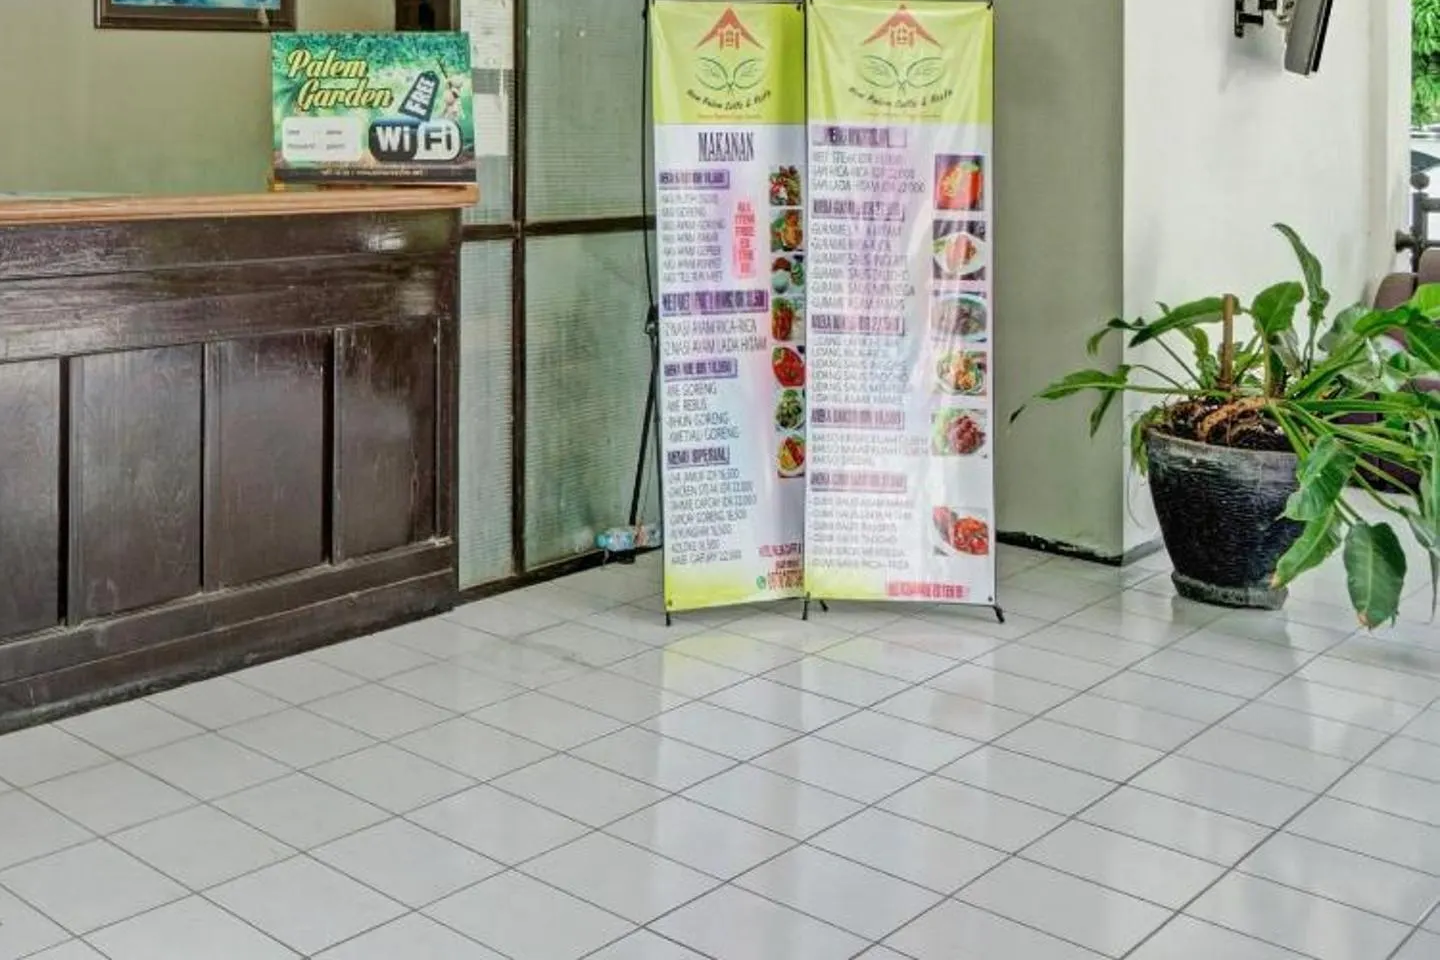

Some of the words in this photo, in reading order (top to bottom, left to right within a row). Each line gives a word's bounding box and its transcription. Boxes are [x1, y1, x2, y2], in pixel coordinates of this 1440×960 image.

[288, 49, 368, 78] Palem
[297, 78, 394, 111] Garden
[405, 76, 436, 116] FREE
[697, 132, 756, 162] MAKANAN
